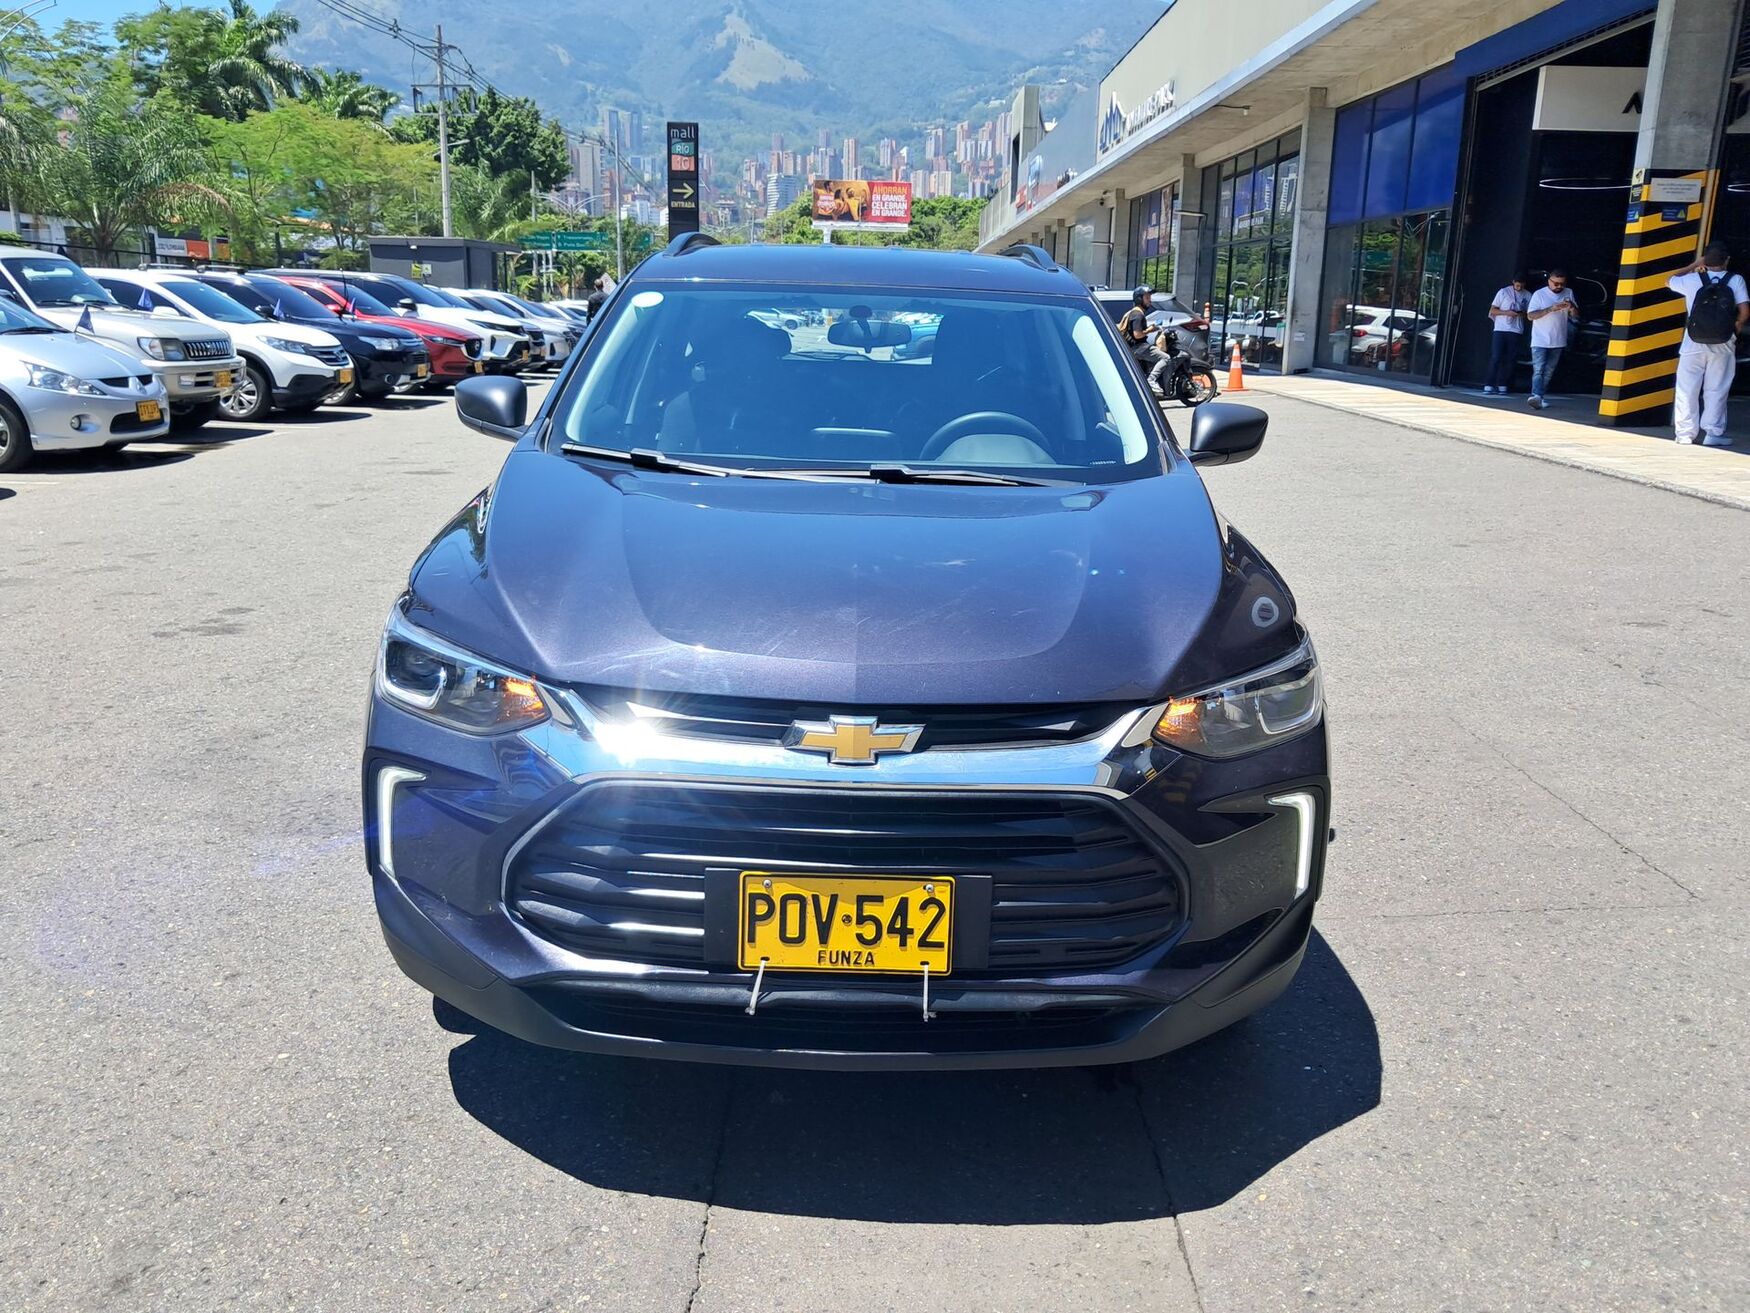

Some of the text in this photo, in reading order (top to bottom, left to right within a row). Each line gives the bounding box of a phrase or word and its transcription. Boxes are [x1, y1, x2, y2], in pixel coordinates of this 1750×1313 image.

[670, 126, 695, 138] mall
[873, 185, 907, 195] AHORRAN
[872, 194, 881, 202] EN
[872, 202, 907, 210] CELEBRAN
[817, 950, 875, 966] FUNZA
